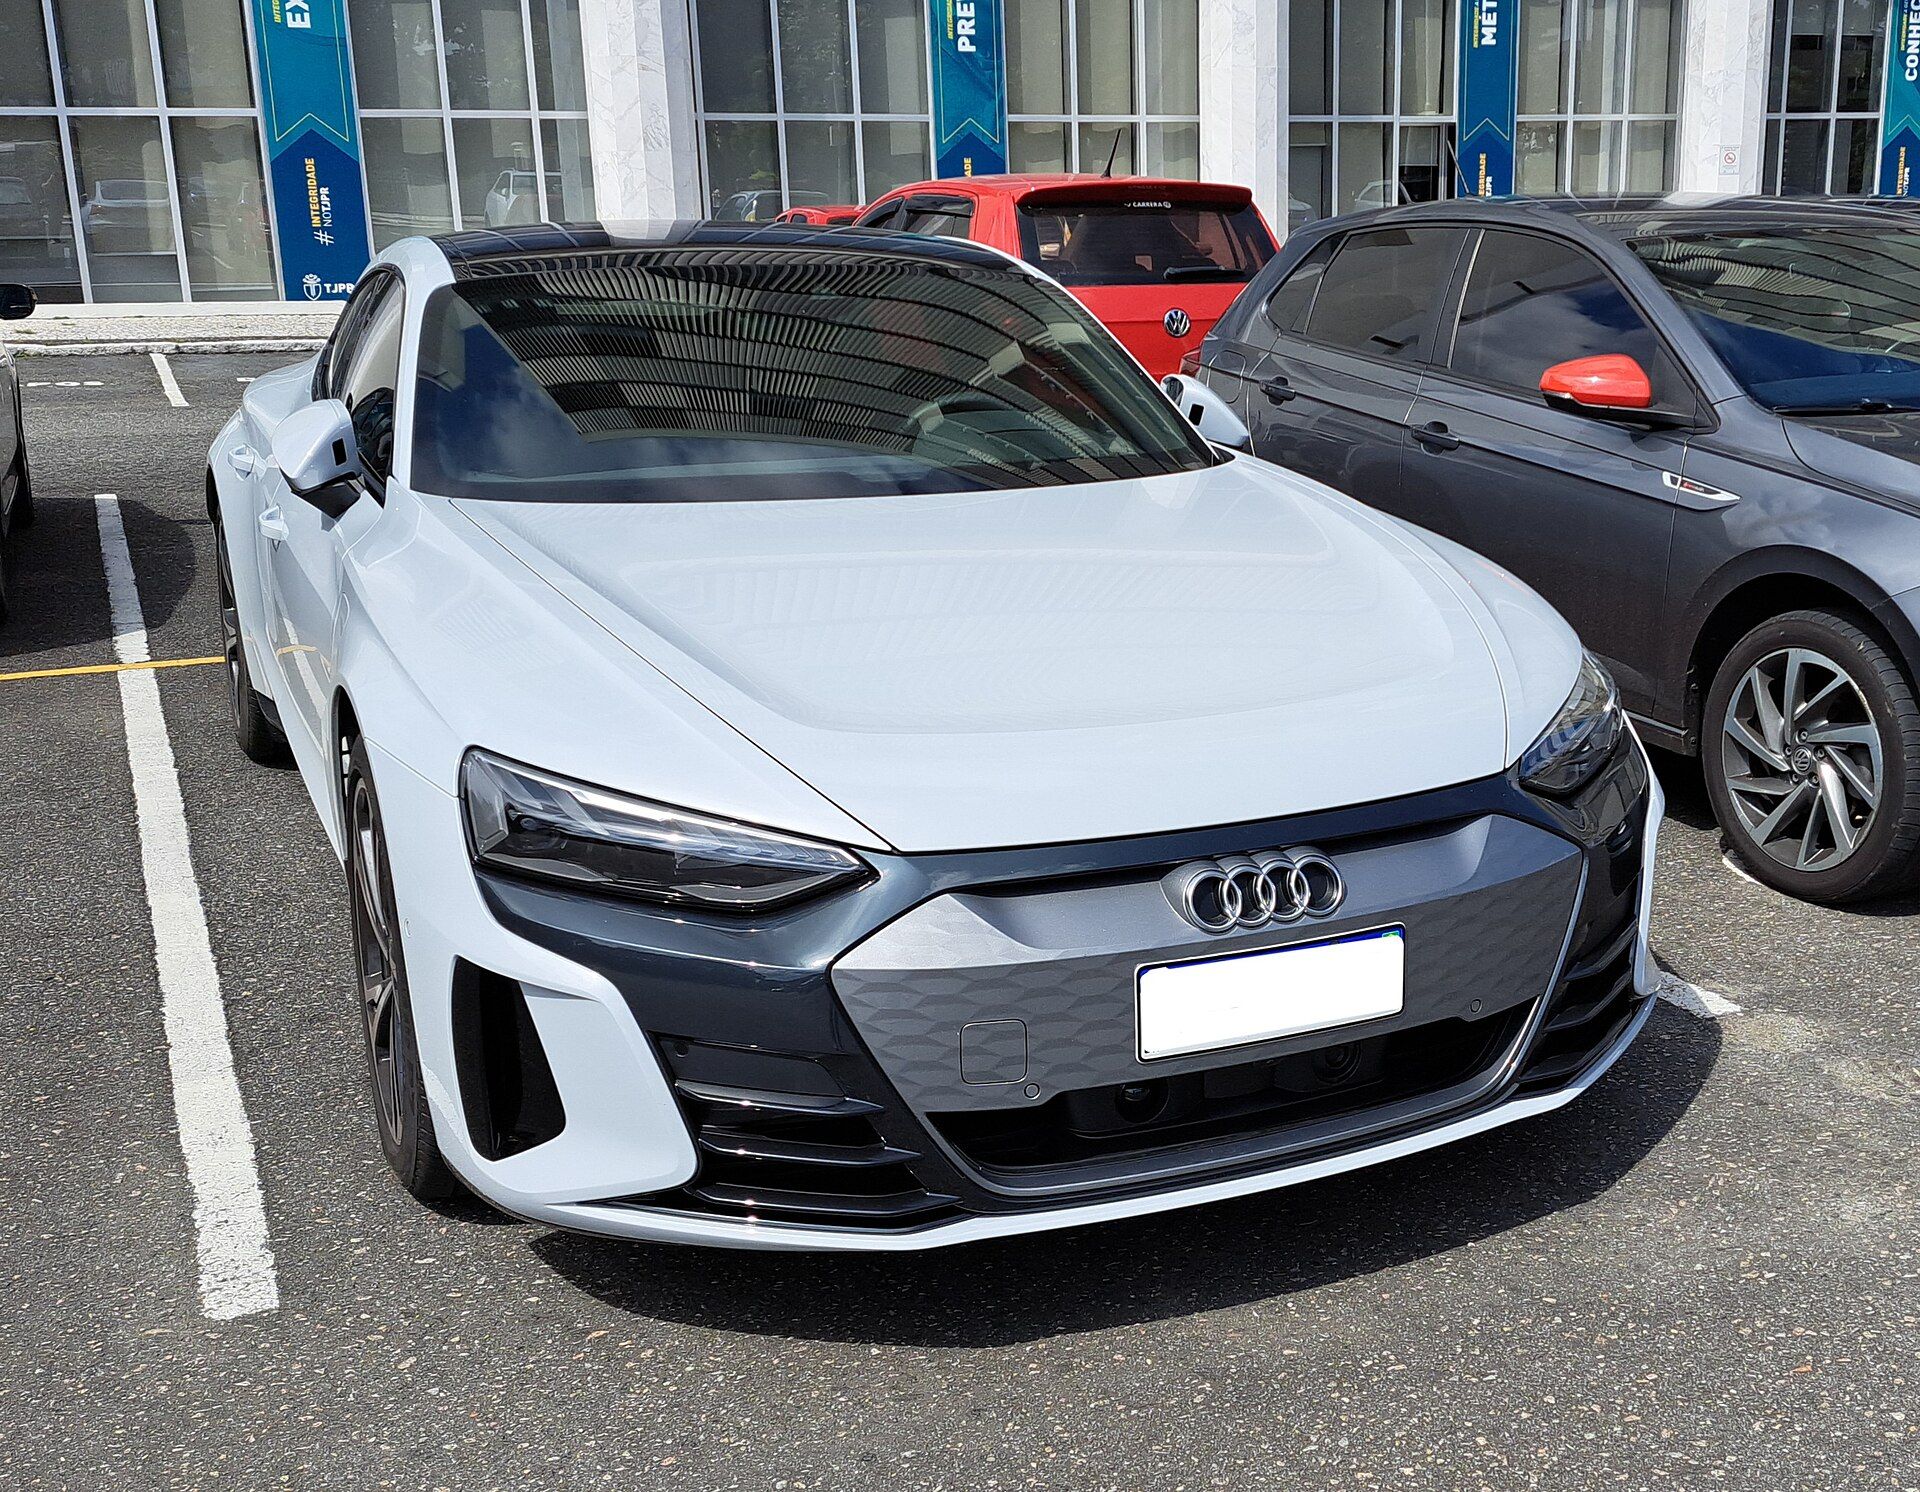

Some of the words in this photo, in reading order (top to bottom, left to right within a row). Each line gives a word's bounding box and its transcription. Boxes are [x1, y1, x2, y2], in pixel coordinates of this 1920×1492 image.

[957, 0, 976, 52] PRE
[304, 157, 322, 228] INTEGRIDADE
[319, 186, 333, 227] NOTJPR
